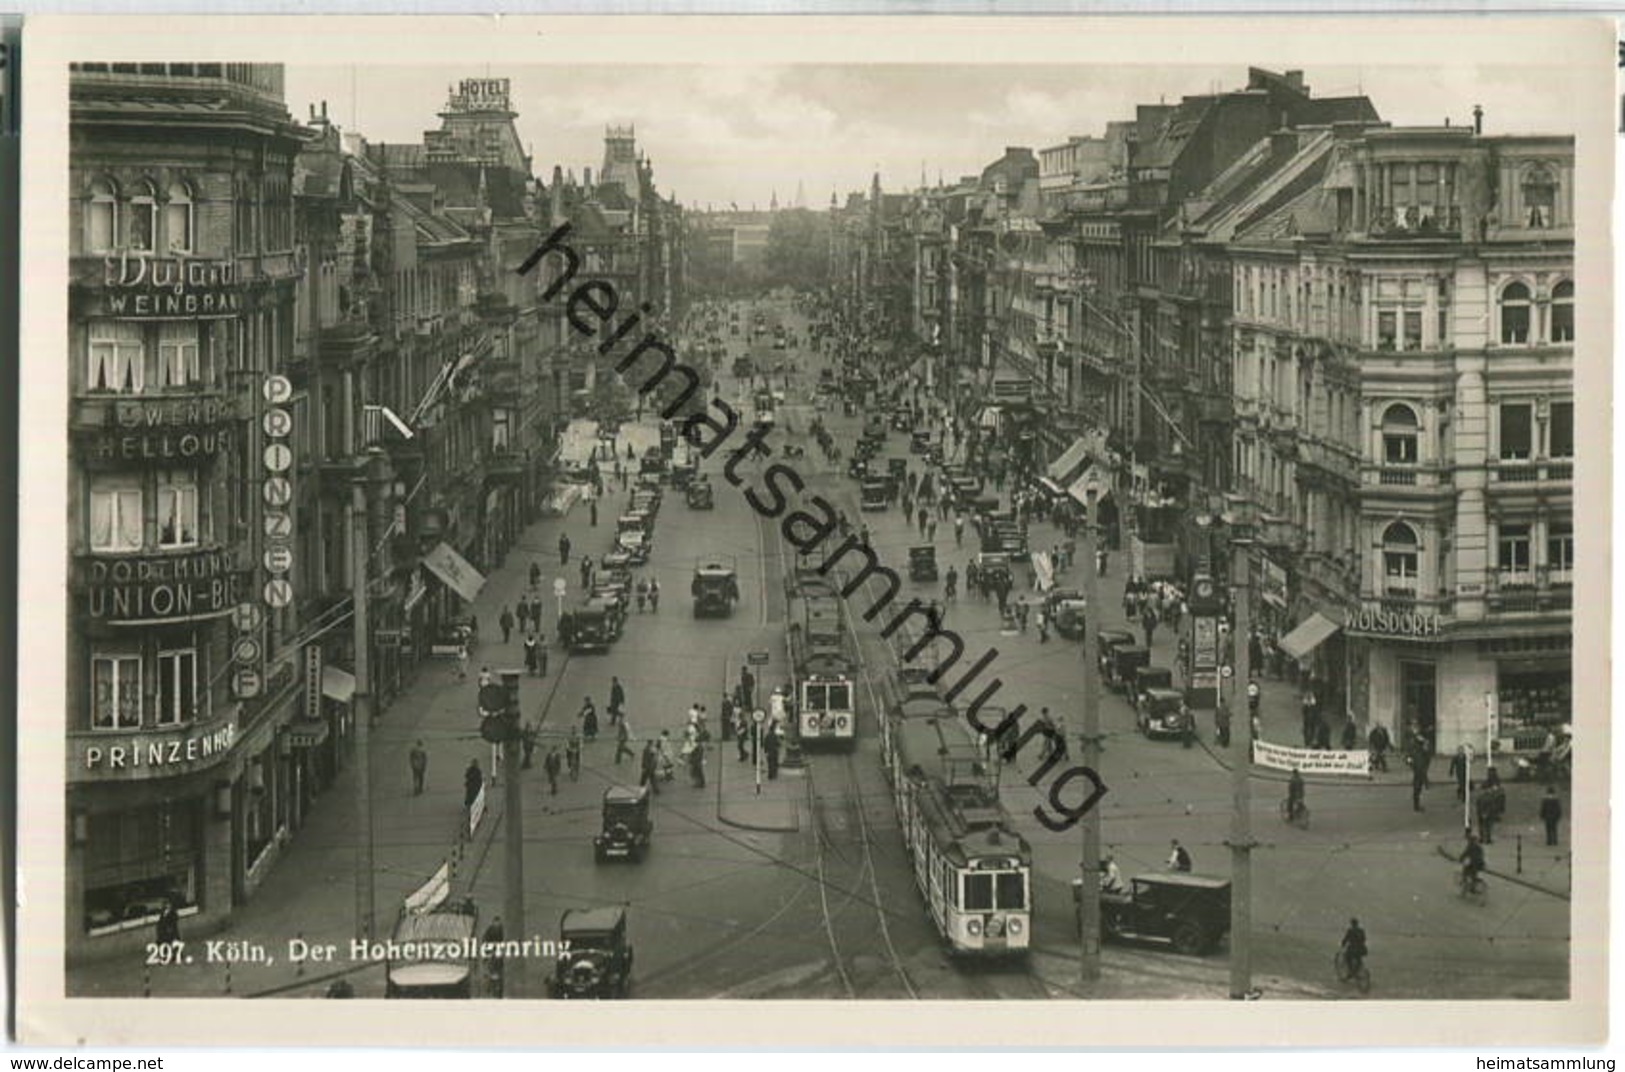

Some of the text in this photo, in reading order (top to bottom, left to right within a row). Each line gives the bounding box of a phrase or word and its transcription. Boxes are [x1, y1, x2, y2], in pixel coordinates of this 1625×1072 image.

[459, 80, 502, 96] HOTEL
[264, 375, 292, 608] PRINZEN
[1344, 607, 1443, 635] WOLSDORFF
[232, 602, 260, 698] HOF
[87, 723, 233, 768] PRINZENHOF
